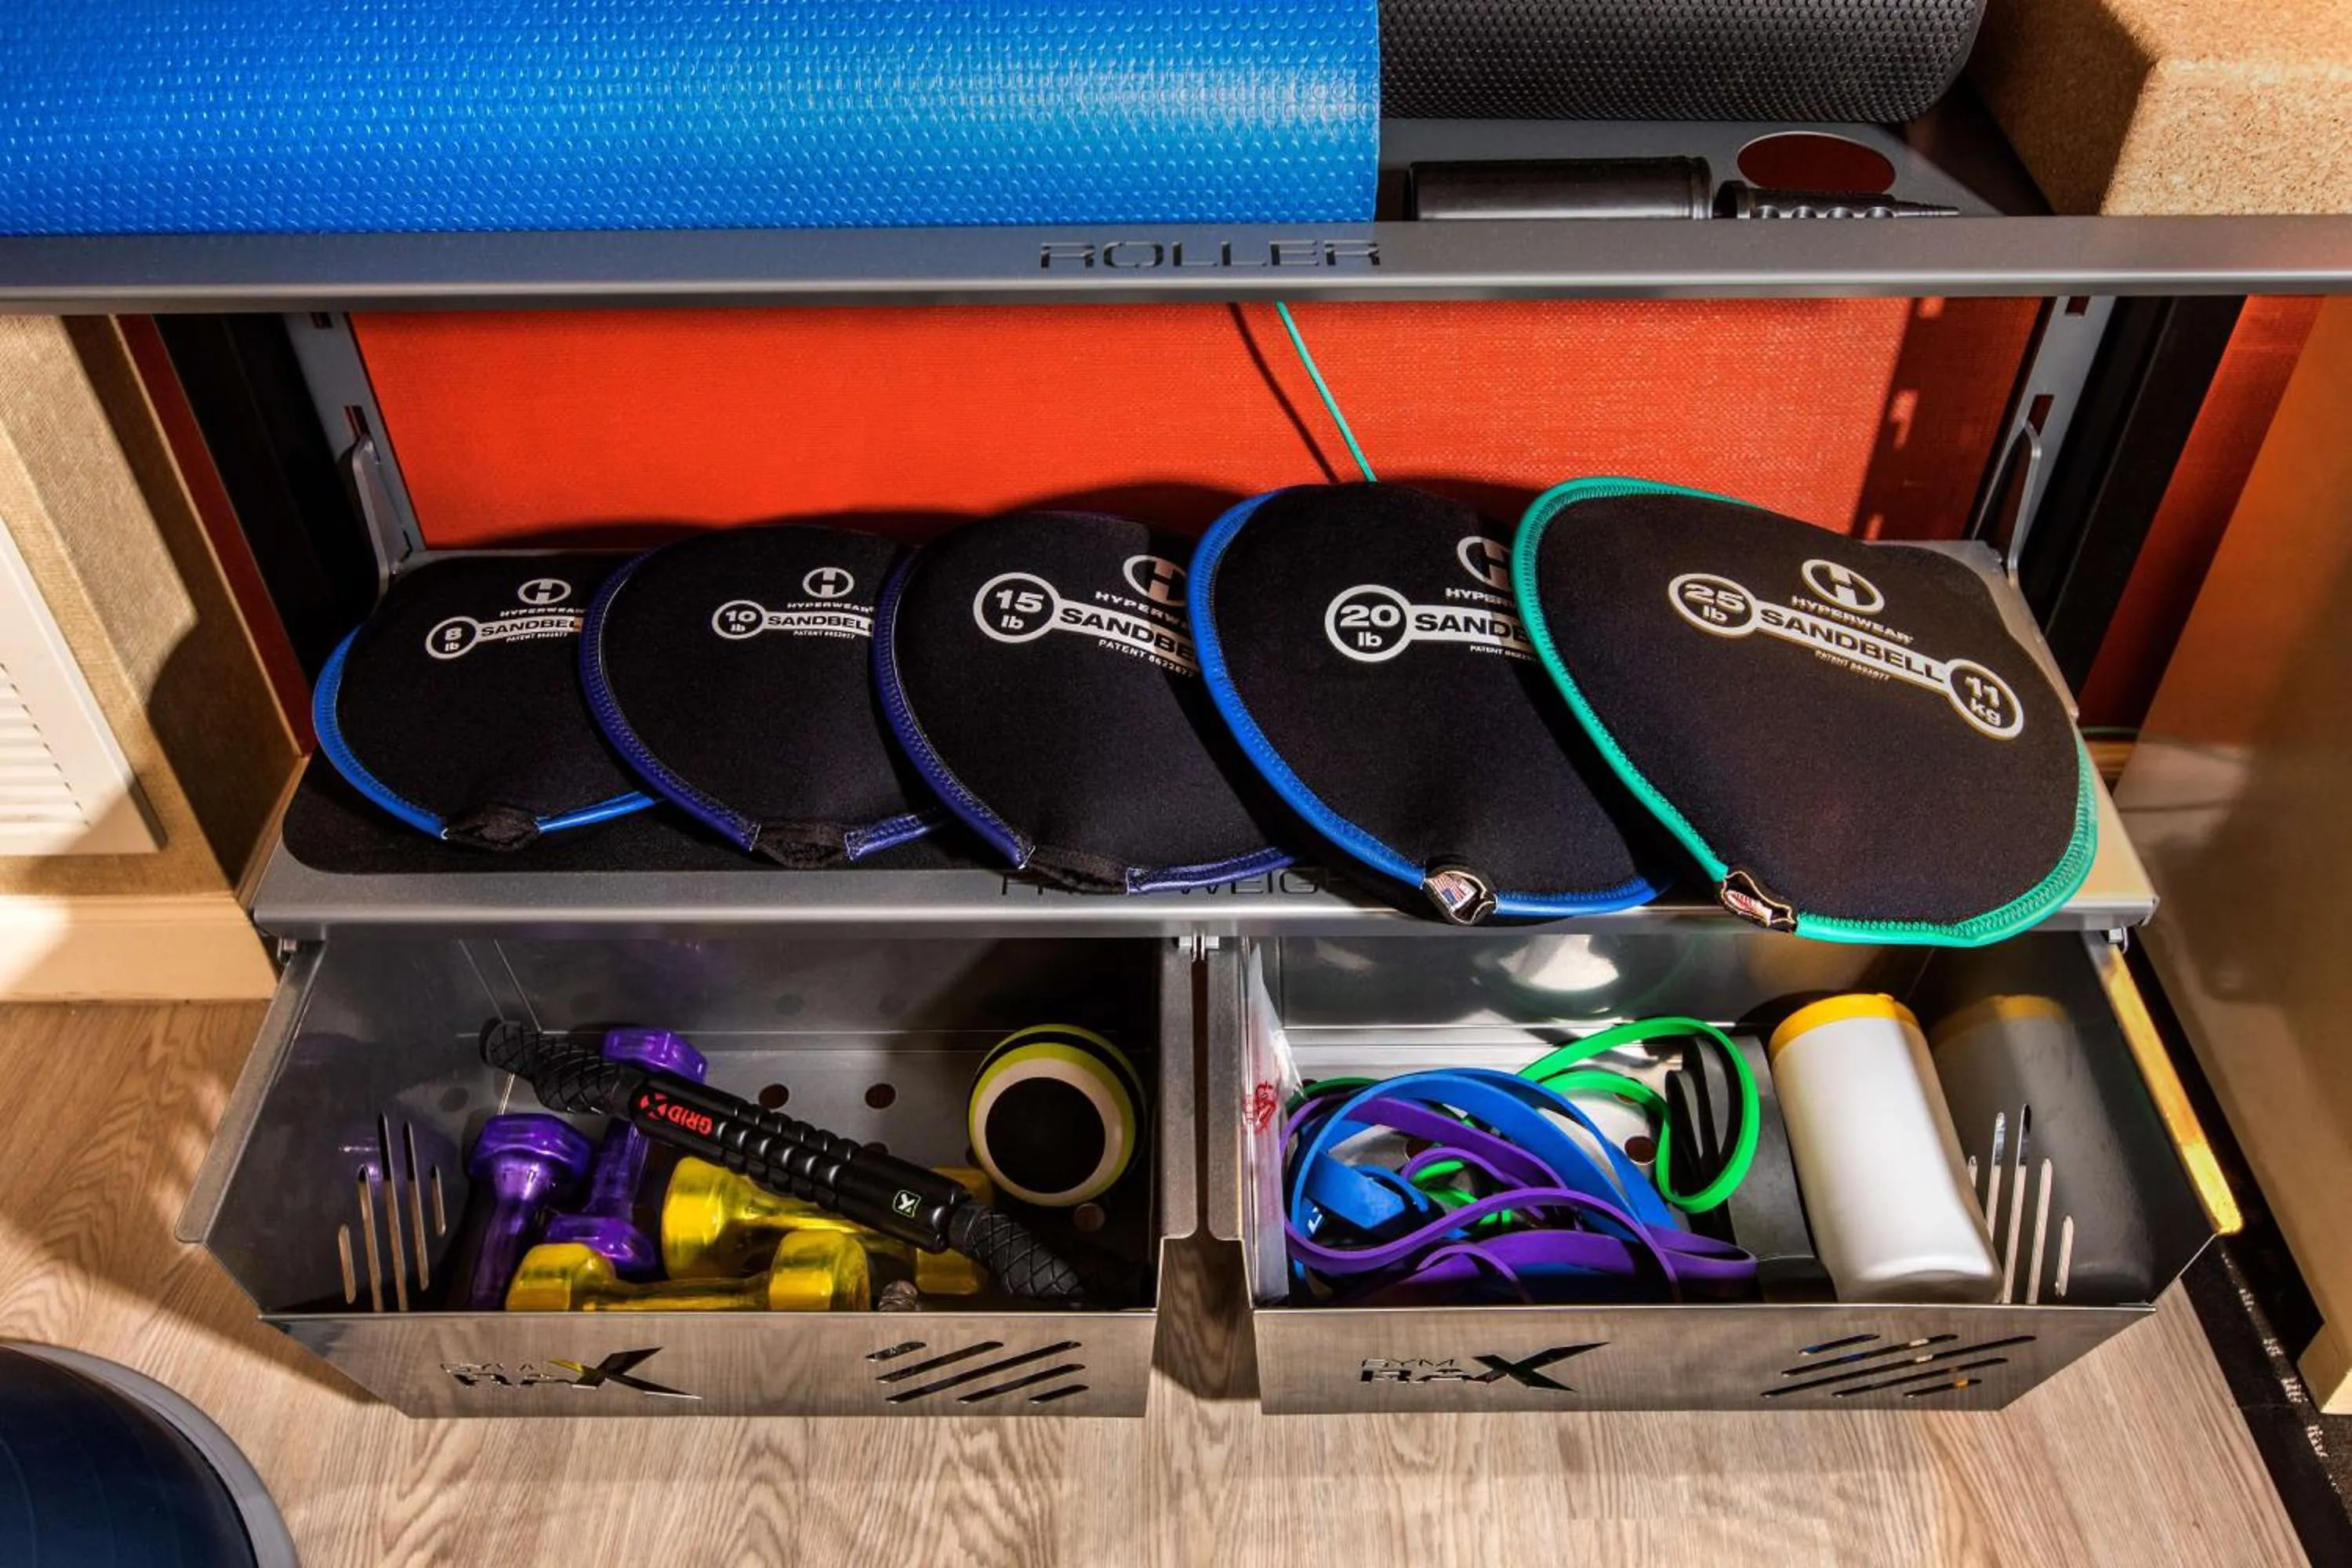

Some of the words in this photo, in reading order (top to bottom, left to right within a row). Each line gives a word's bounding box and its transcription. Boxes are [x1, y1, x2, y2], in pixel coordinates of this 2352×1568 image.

[1040, 241, 1381, 269] ROLLER
[996, 590, 1044, 613] 15
[1684, 583, 1746, 614] 25
[725, 610, 757, 622] 10
[1000, 615, 1024, 629] lb
[1340, 604, 1400, 627] 20
[1702, 605, 1727, 624] lb
[445, 627, 462, 641] 8
[731, 624, 746, 633] lb
[445, 642, 459, 652] lb
[1098, 639, 1145, 658] PATENT
[1358, 632, 1382, 647] lb
[1761, 608, 1944, 683] SANDBELL
[1965, 676, 1999, 707] 11
[1970, 697, 2001, 727] kg
[667, 1105, 713, 1135] GRID
